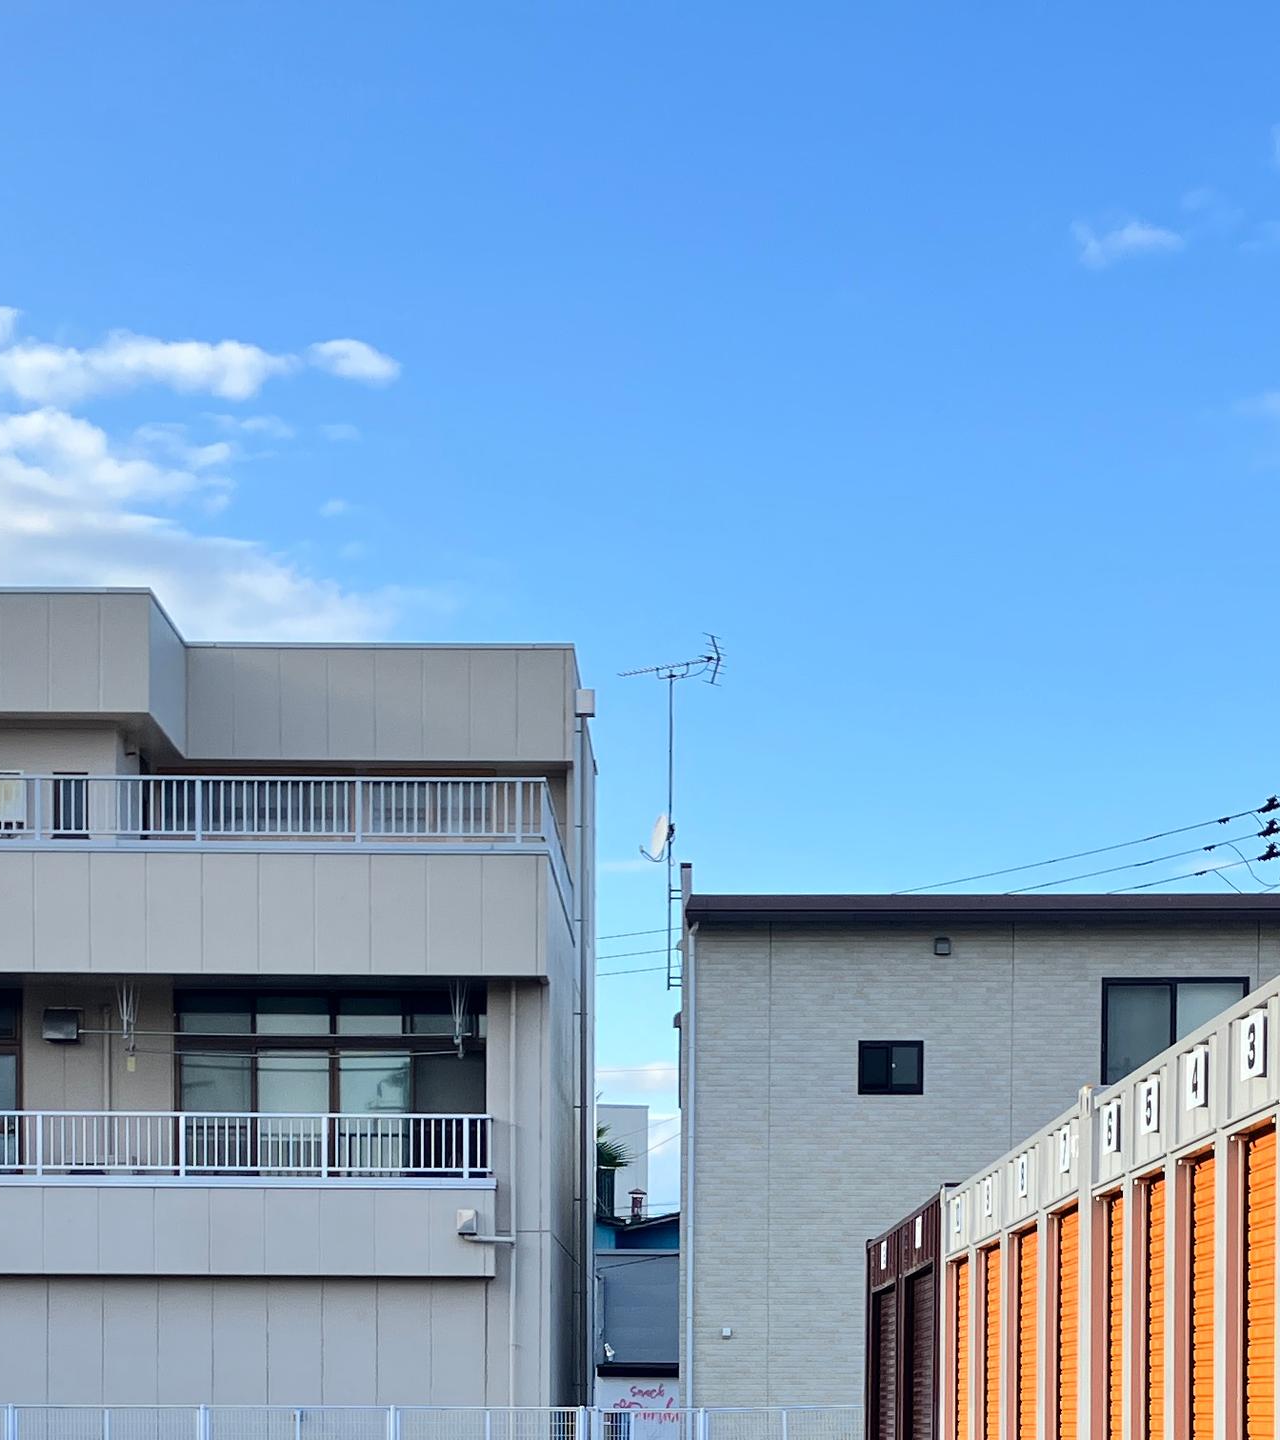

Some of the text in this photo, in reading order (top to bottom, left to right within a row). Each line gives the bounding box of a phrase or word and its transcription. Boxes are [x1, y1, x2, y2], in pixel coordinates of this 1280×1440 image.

[1247, 1023, 1256, 1069] 3
[1192, 1058, 1199, 1099] 4
[1146, 1087, 1152, 1127] 5
[1107, 1111, 1113, 1147] 6
